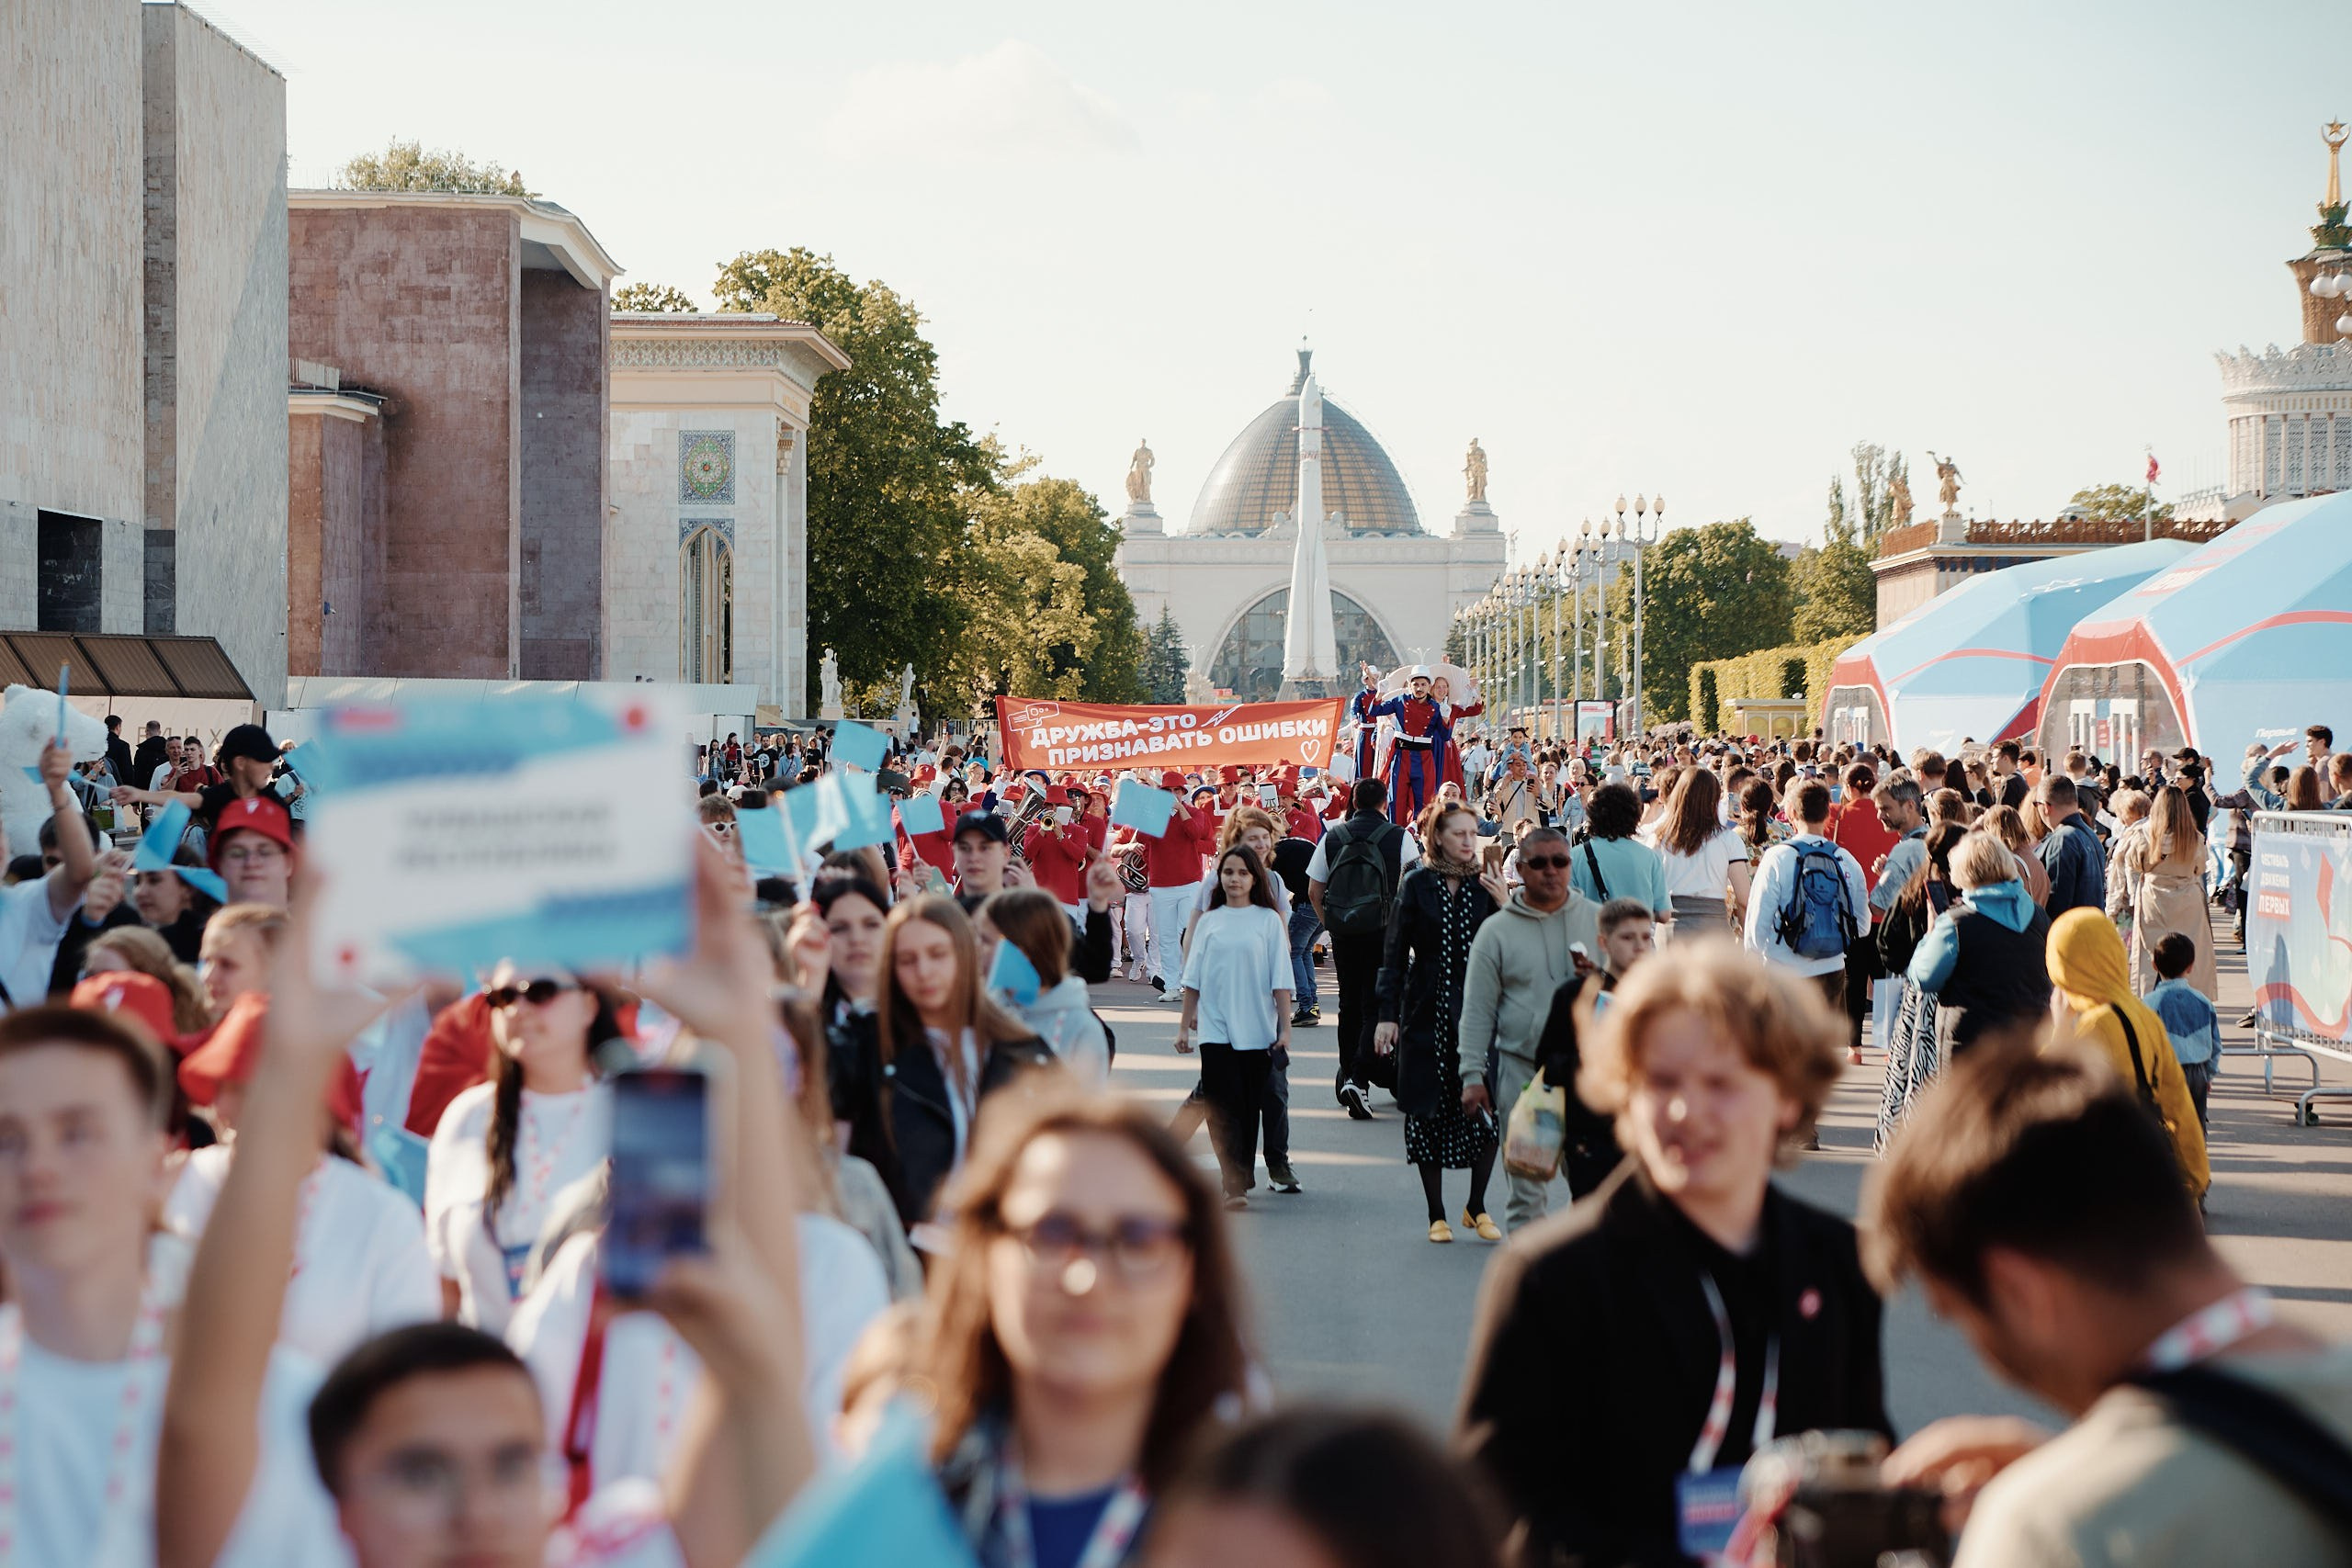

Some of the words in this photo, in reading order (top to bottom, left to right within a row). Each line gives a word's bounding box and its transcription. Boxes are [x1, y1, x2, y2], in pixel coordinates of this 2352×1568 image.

[1047, 731, 1213, 766] ПРИЗНАВАТЬ
[1218, 718, 1328, 744] ОШИБКИ
[2258, 895, 2290, 916] ПЕРВЫХ
